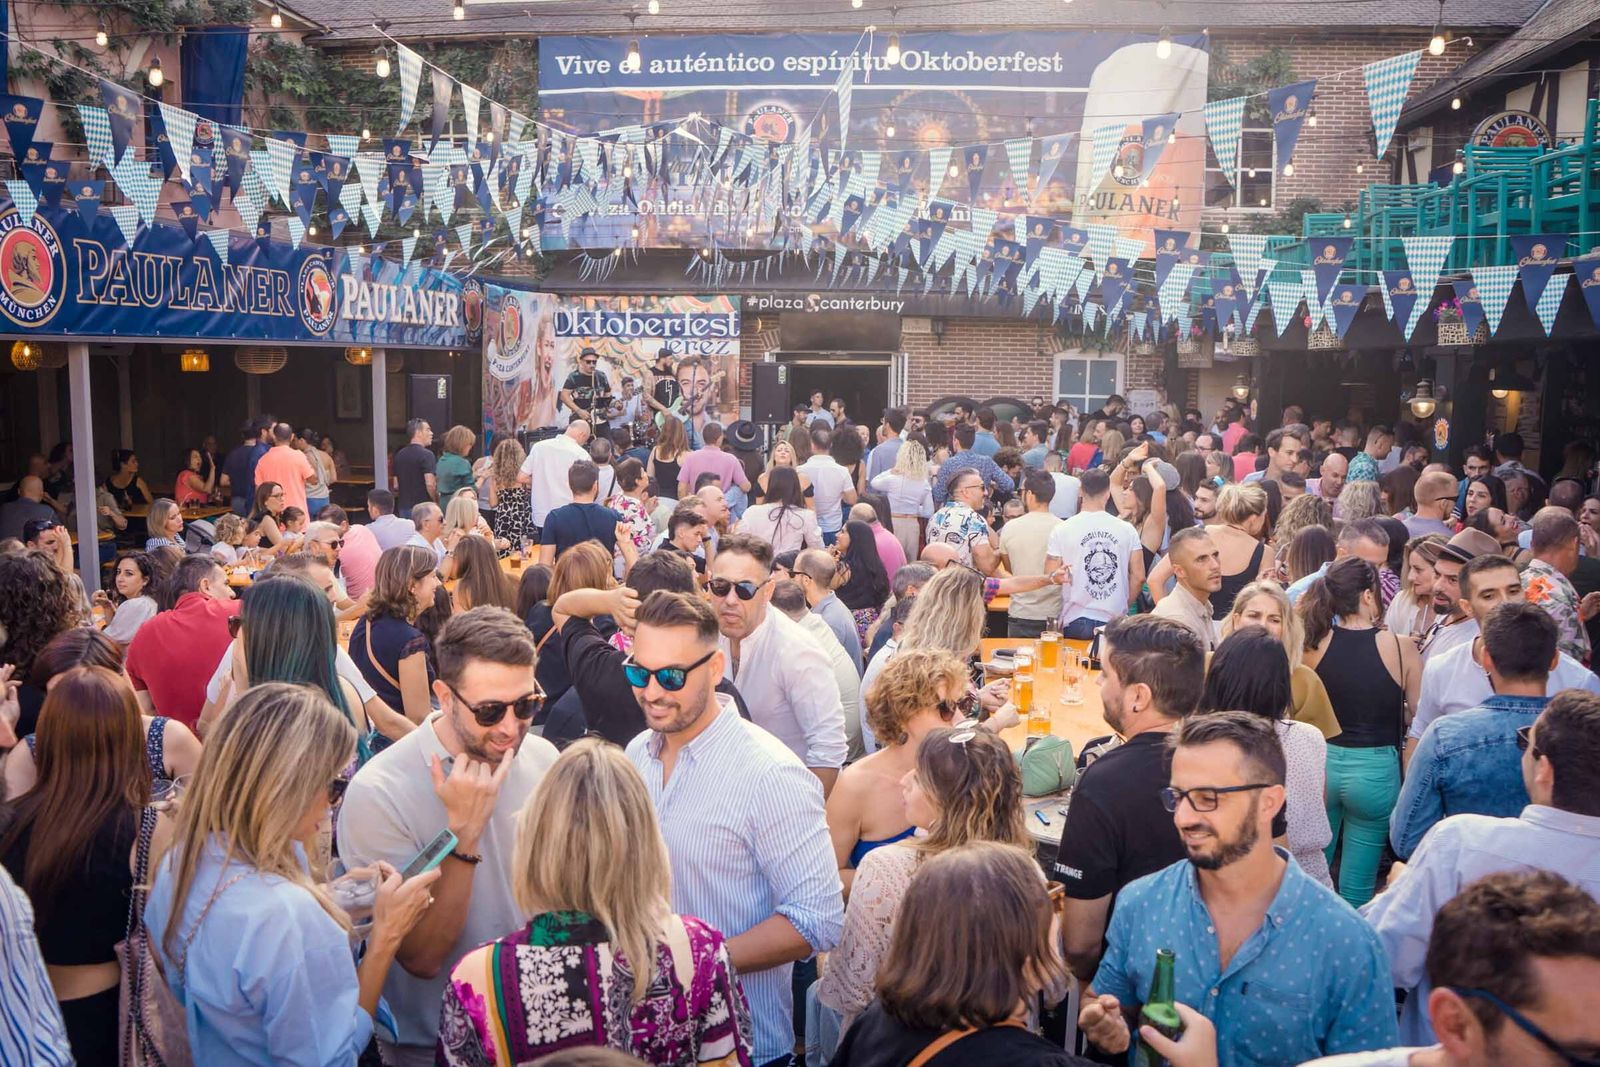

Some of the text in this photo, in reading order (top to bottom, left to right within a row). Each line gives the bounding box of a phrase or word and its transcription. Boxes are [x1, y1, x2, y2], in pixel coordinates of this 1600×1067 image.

[555, 49, 1063, 77] Vive e auténtico espíritu Oktoberfest
[1481, 114, 1548, 145] PAULANER
[73, 237, 295, 318] PAULANER
[0, 290, 56, 320] MÜNCHEN
[341, 273, 460, 328] PAULANER
[746, 295, 905, 314] #plaza canterbury
[554, 306, 741, 338] Oktoberfest
